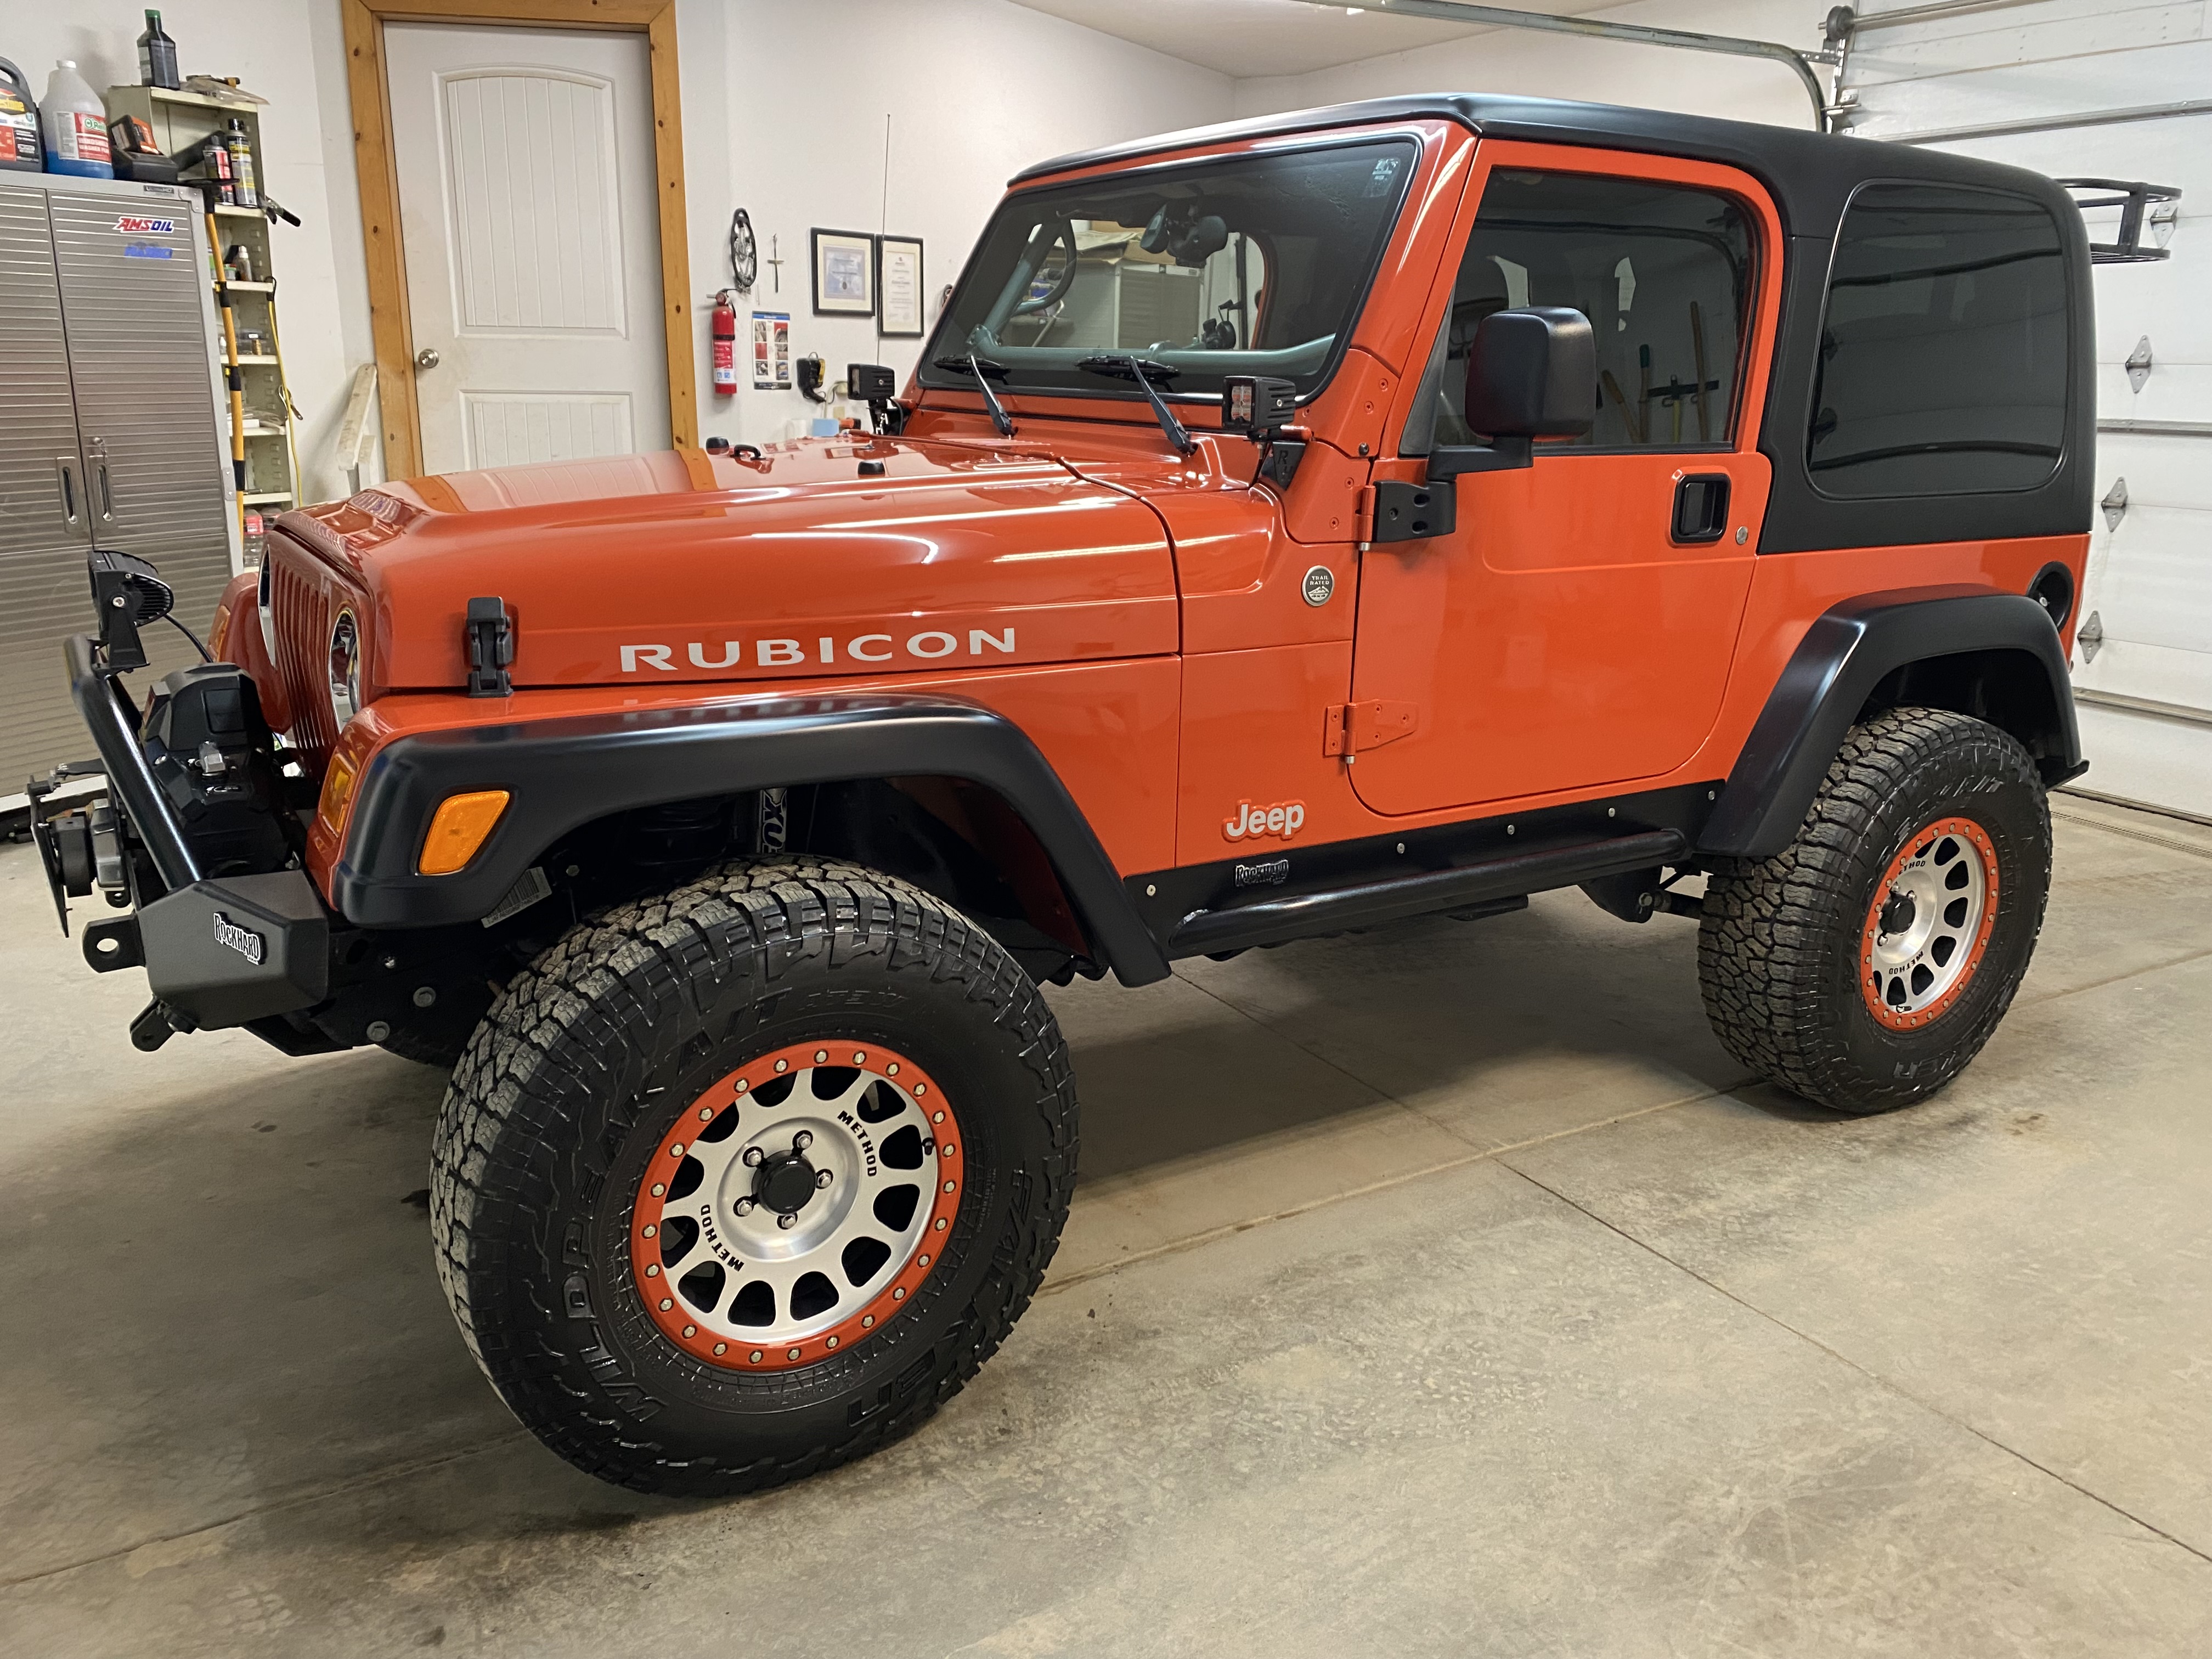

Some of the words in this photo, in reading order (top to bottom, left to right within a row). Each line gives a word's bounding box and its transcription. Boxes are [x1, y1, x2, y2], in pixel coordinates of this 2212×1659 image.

[116, 218, 172, 232] AMSOIL
[620, 628, 1014, 672] RUBICON
[1227, 804, 1304, 836] Jeep
[213, 913, 260, 960] ROCKHARD
[1889, 951, 1923, 974] METHOD
[837, 1110, 877, 1176] METHOD
[701, 1204, 744, 1272] METHOD
